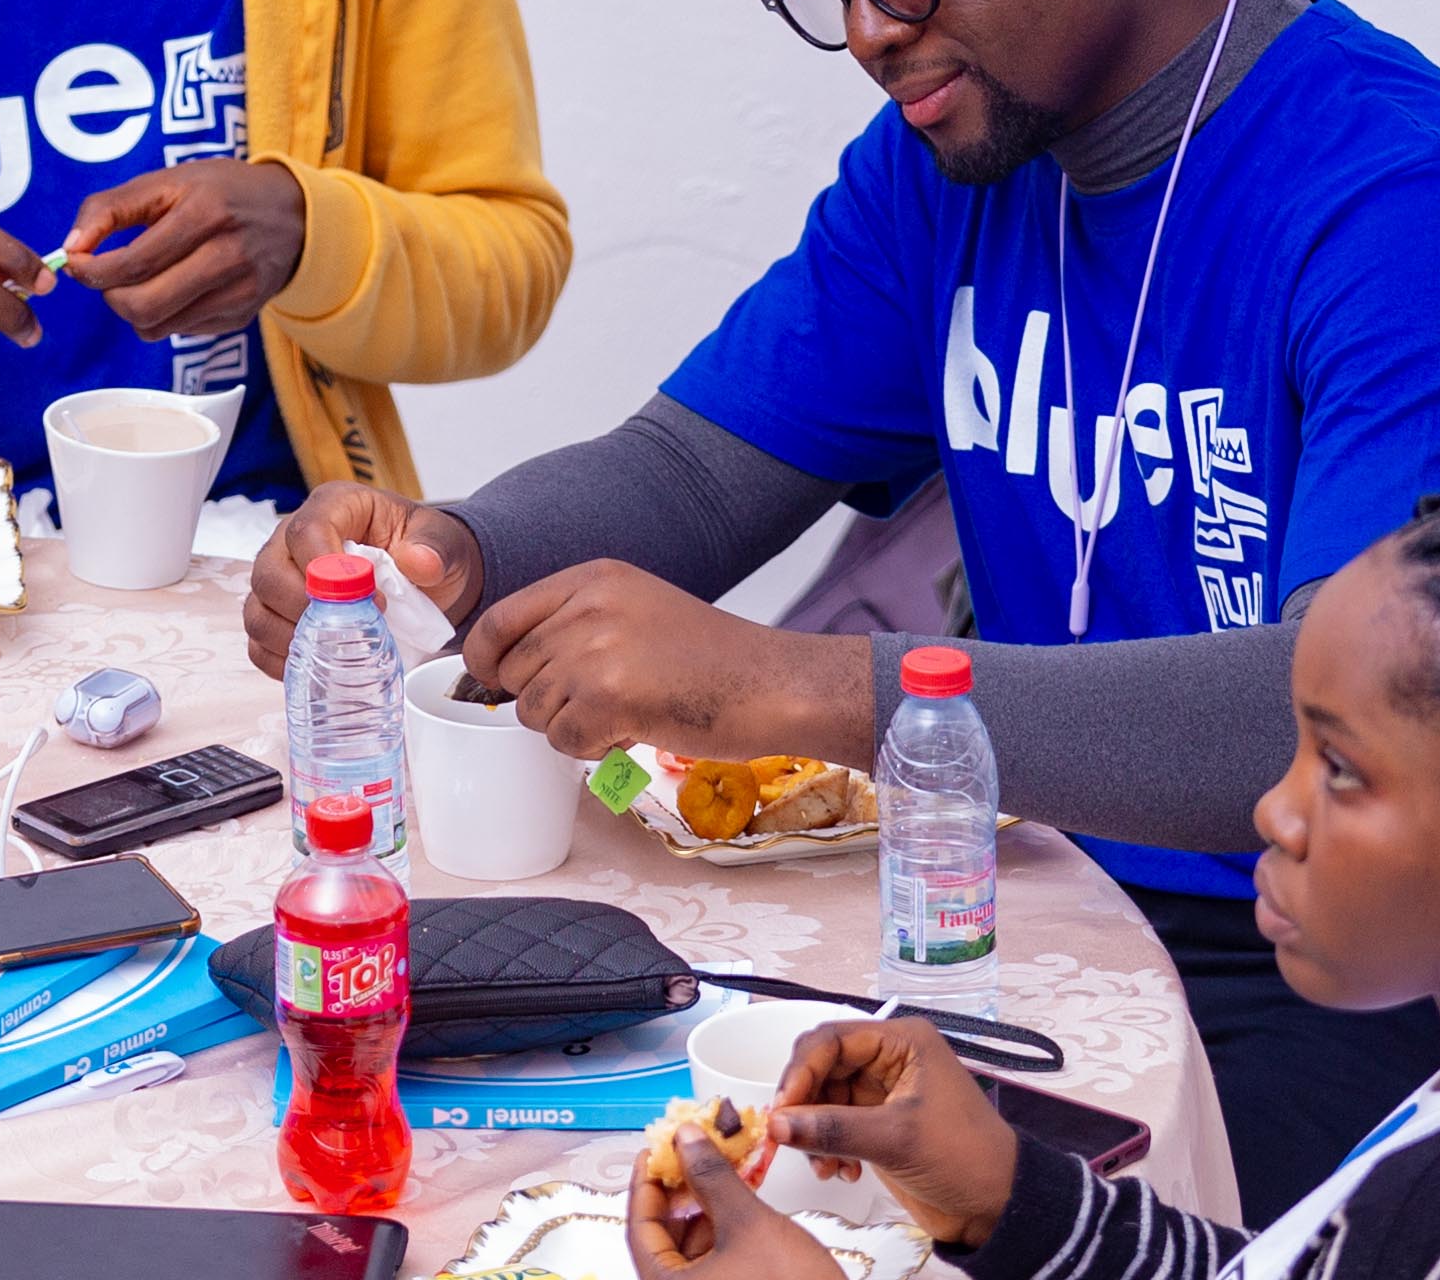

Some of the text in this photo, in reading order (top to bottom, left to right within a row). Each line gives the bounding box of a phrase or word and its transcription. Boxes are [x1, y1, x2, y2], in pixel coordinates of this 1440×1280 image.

[0, 989, 52, 1035] camtel
[103, 1022, 169, 1067] camtel
[486, 1107, 575, 1128] camtel
